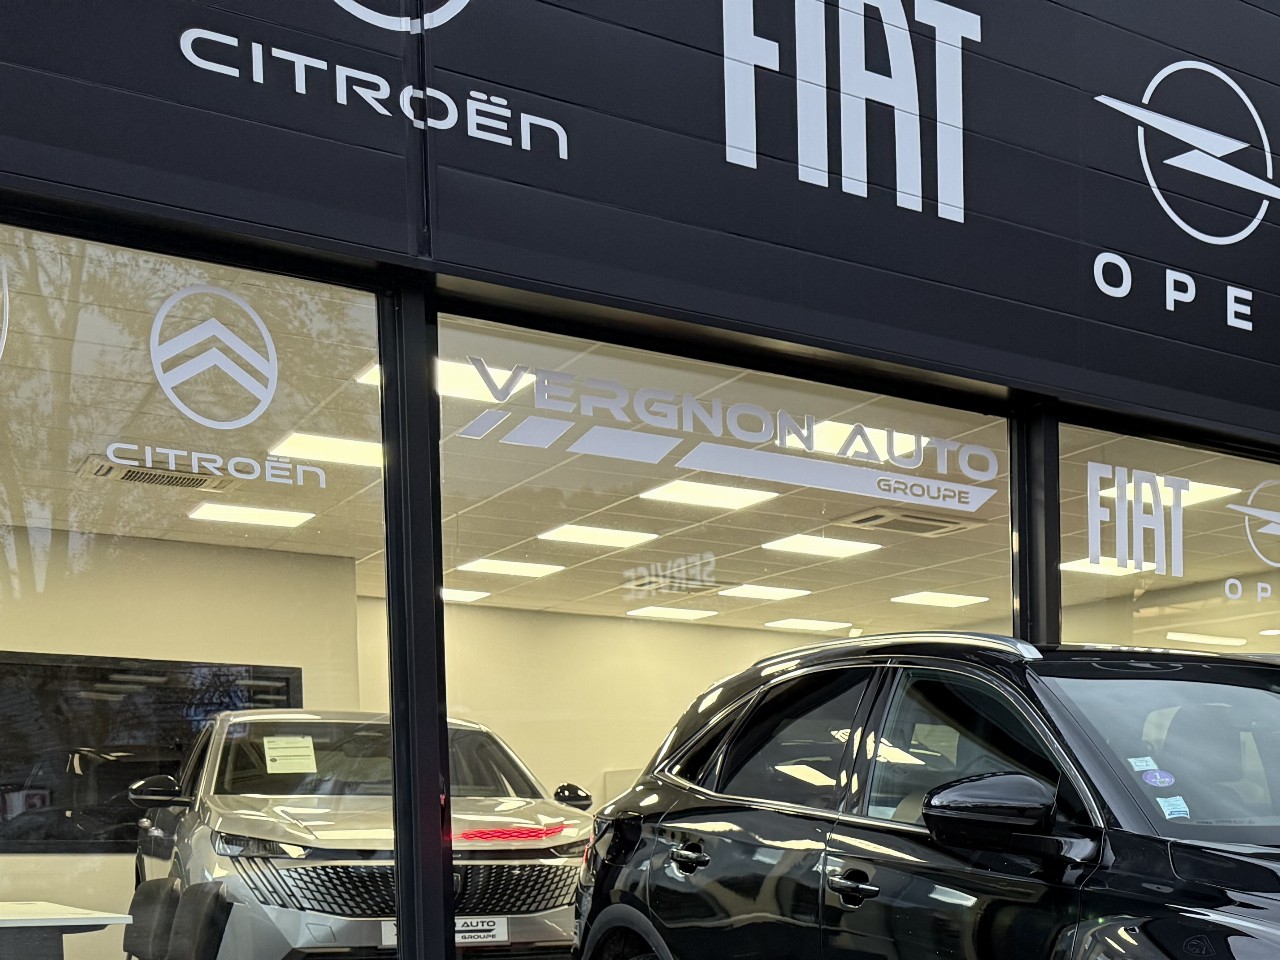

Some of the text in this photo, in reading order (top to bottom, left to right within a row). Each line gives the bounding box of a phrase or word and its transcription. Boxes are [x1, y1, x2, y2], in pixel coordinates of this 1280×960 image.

[723, 0, 981, 224] FIAT
[467, 356, 999, 482] VERGNON AUTO
[876, 476, 970, 506] GROUPE
[1087, 461, 1190, 577] FIAT
[460, 920, 496, 928] AUTO
